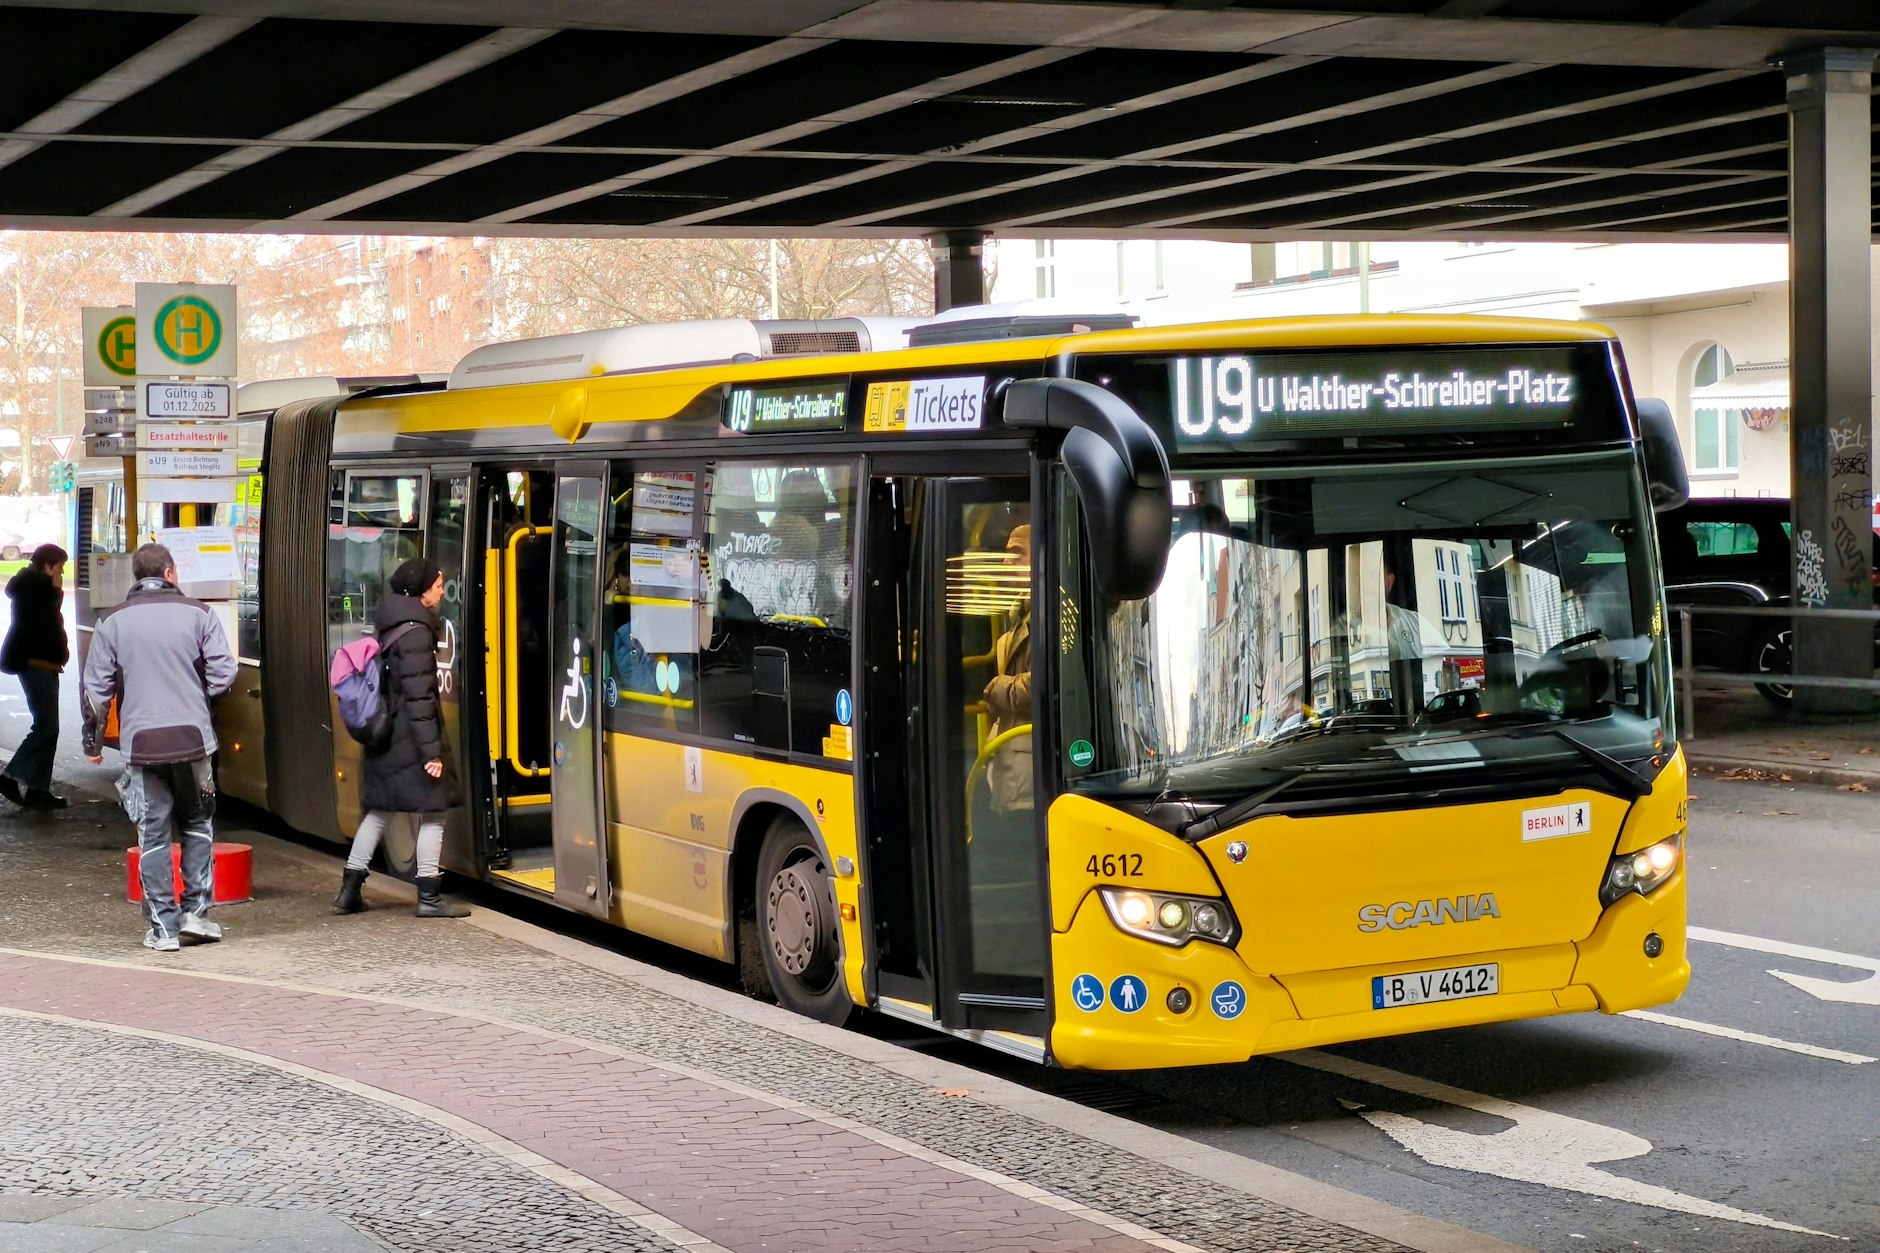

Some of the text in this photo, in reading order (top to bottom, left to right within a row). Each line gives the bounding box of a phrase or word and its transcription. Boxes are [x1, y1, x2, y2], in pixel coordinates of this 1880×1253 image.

[175, 312, 203, 350] H
[163, 401, 216, 412] 01.12.2025
[165, 388, 214, 401] Gültig ab
[913, 385, 977, 425] Tickets
[1176, 356, 1571, 436] U9 U Walther-Schreiber-Platz
[731, 390, 752, 431] U9
[150, 432, 228, 441] Ersatzhaltestelle
[155, 456, 167, 465] U9
[1527, 815, 1565, 831] BERLIN
[1086, 853, 1144, 877] 4612
[1358, 892, 1501, 933] SCANIA
[1392, 978, 1405, 1002] B
[1420, 974, 1433, 999] V
[1439, 968, 1489, 996] 4612
